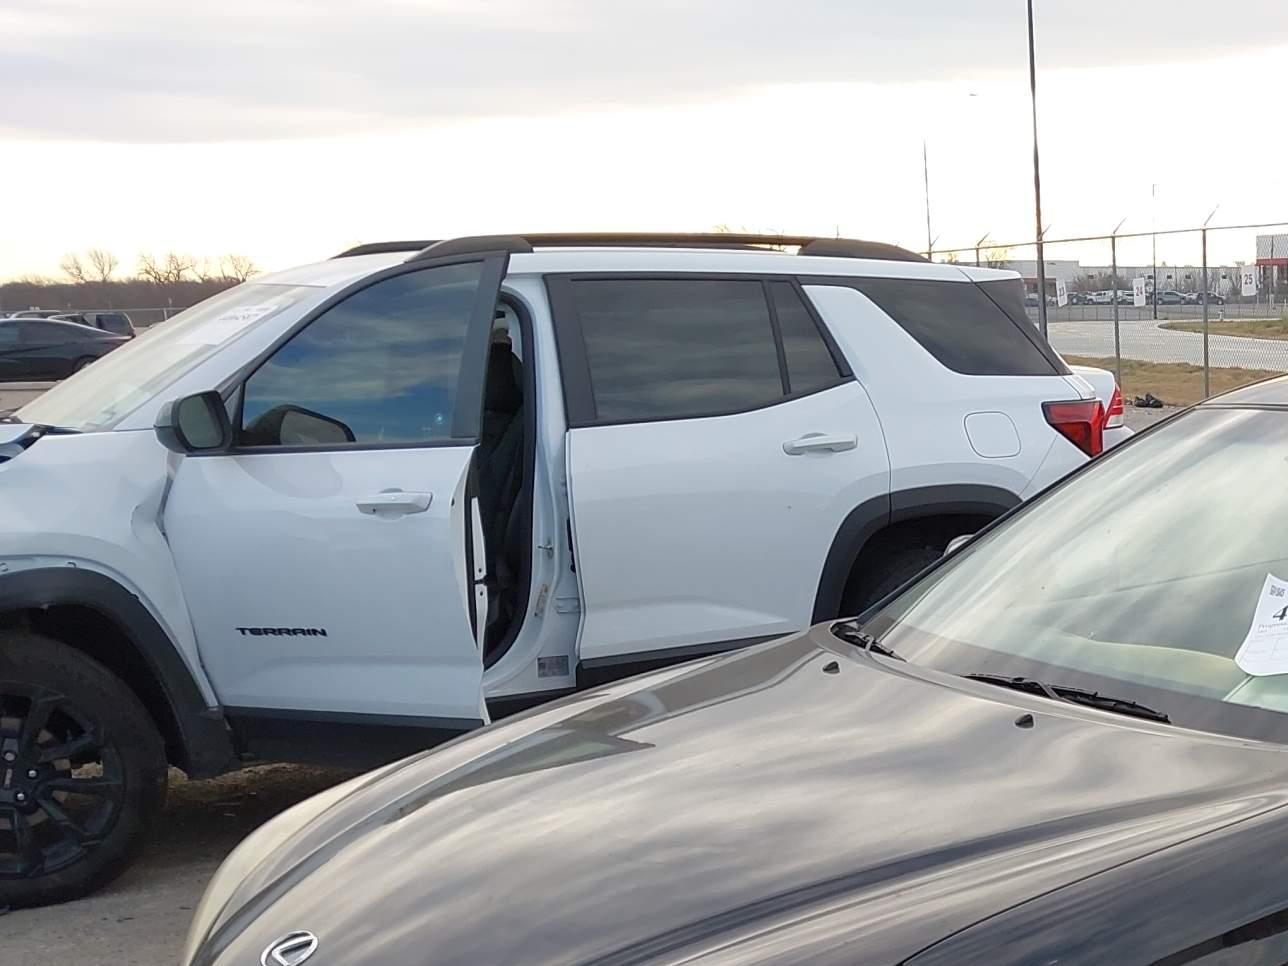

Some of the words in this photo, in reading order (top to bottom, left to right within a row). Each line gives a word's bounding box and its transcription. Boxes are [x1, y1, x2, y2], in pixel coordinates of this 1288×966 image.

[1243, 274, 1253, 286] 25
[1135, 286, 1144, 297] 24
[235, 627, 328, 637] TERRAIN
